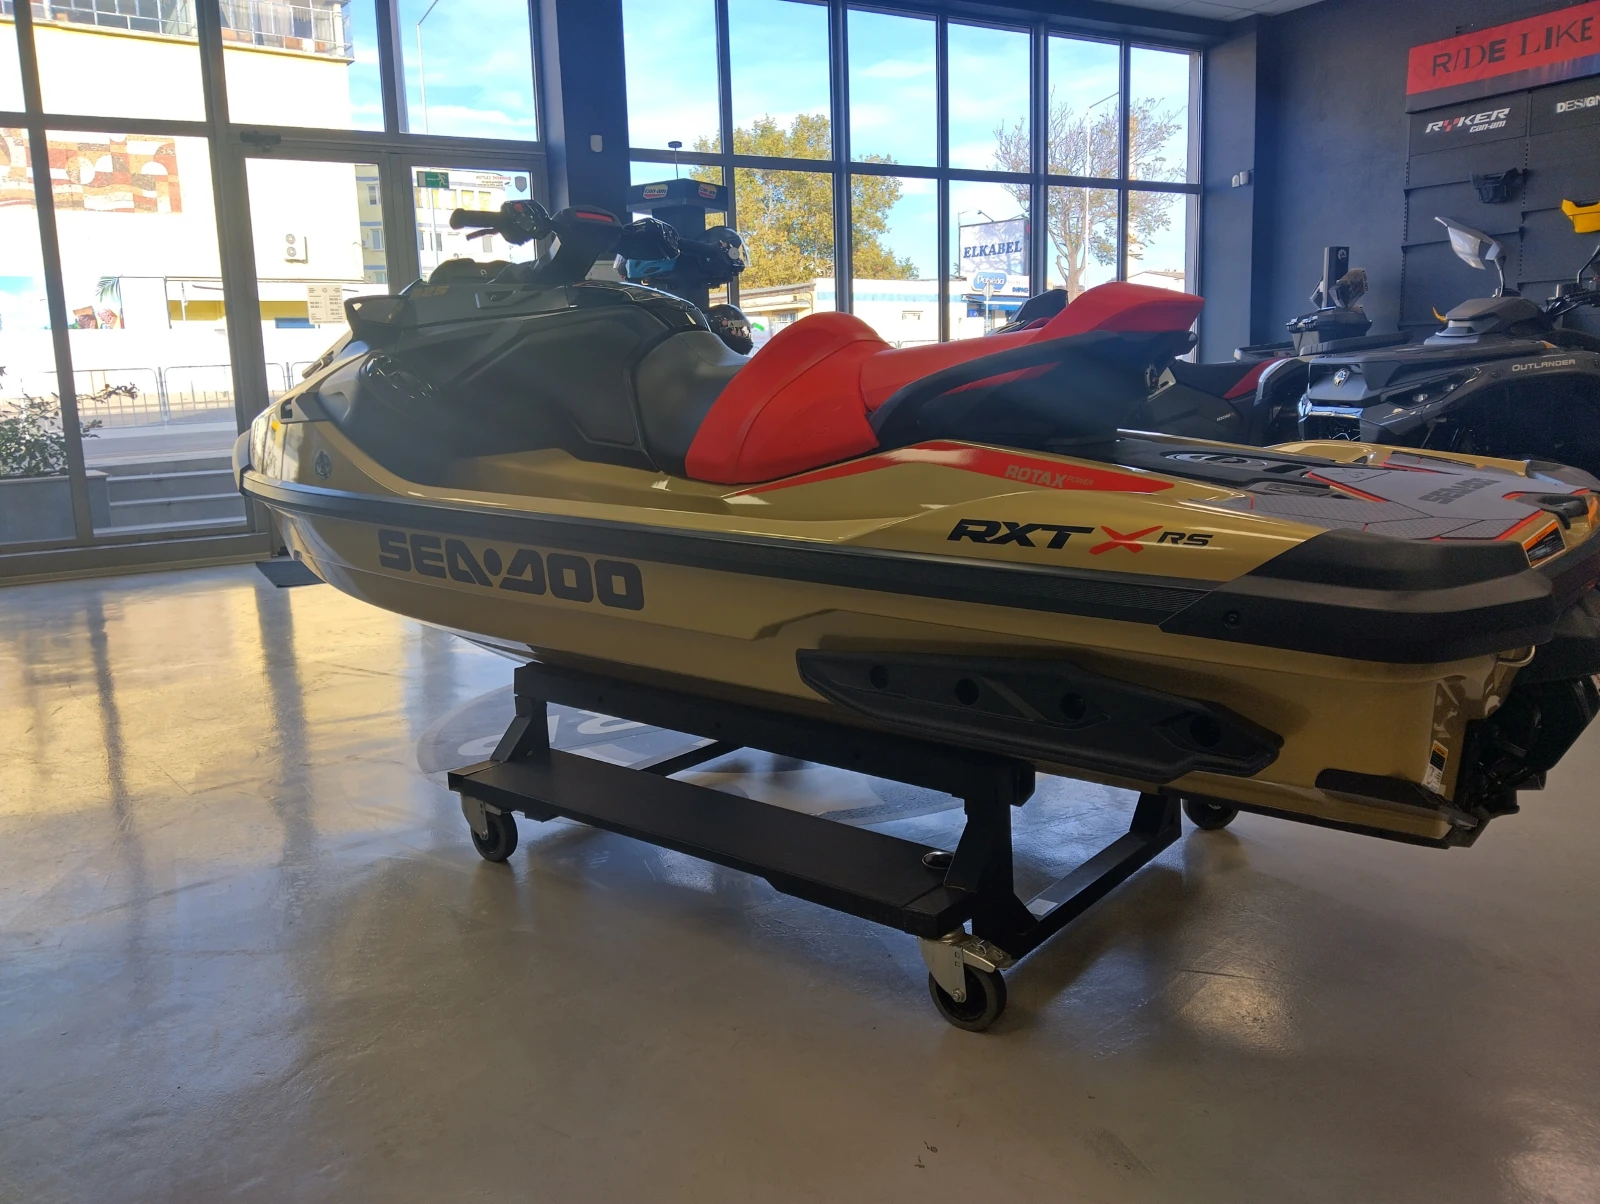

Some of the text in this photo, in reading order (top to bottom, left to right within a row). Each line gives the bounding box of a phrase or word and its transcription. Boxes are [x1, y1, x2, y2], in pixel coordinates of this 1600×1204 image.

[1432, 17, 1594, 76] RIDE LIKE
[1425, 107, 1511, 134] RYKER
[1469, 120, 1506, 133] can-am
[963, 241, 1022, 258] ELKABEL
[1512, 359, 1576, 371] OUTLANDER
[1004, 465, 1068, 488] ROTAX
[947, 519, 1214, 555] RXT X RS
